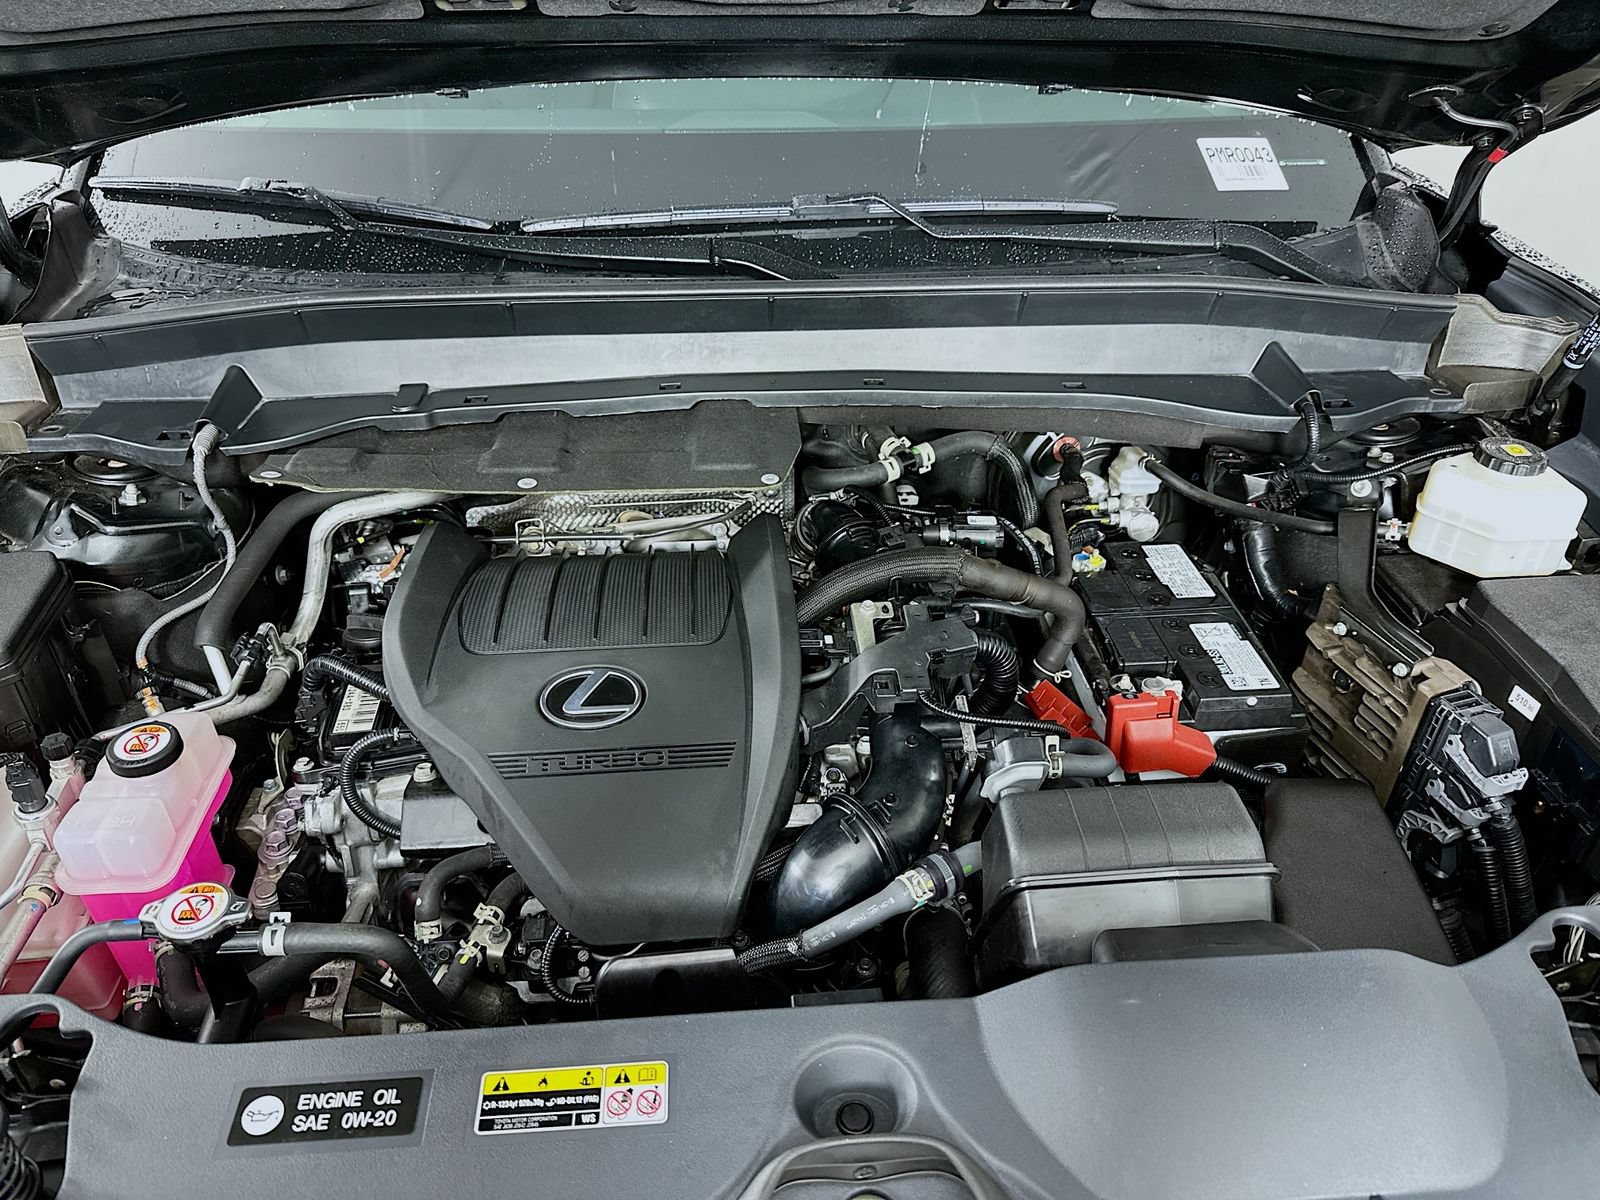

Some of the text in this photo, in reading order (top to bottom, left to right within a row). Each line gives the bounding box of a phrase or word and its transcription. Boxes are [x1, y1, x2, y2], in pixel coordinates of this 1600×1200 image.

[1205, 147, 1273, 163] PMR0043
[531, 750, 666, 771] TURBO
[297, 1088, 401, 1110] ENGINE OIL
[291, 1109, 397, 1133] SAE 0W-20
[581, 1113, 597, 1124] WS
